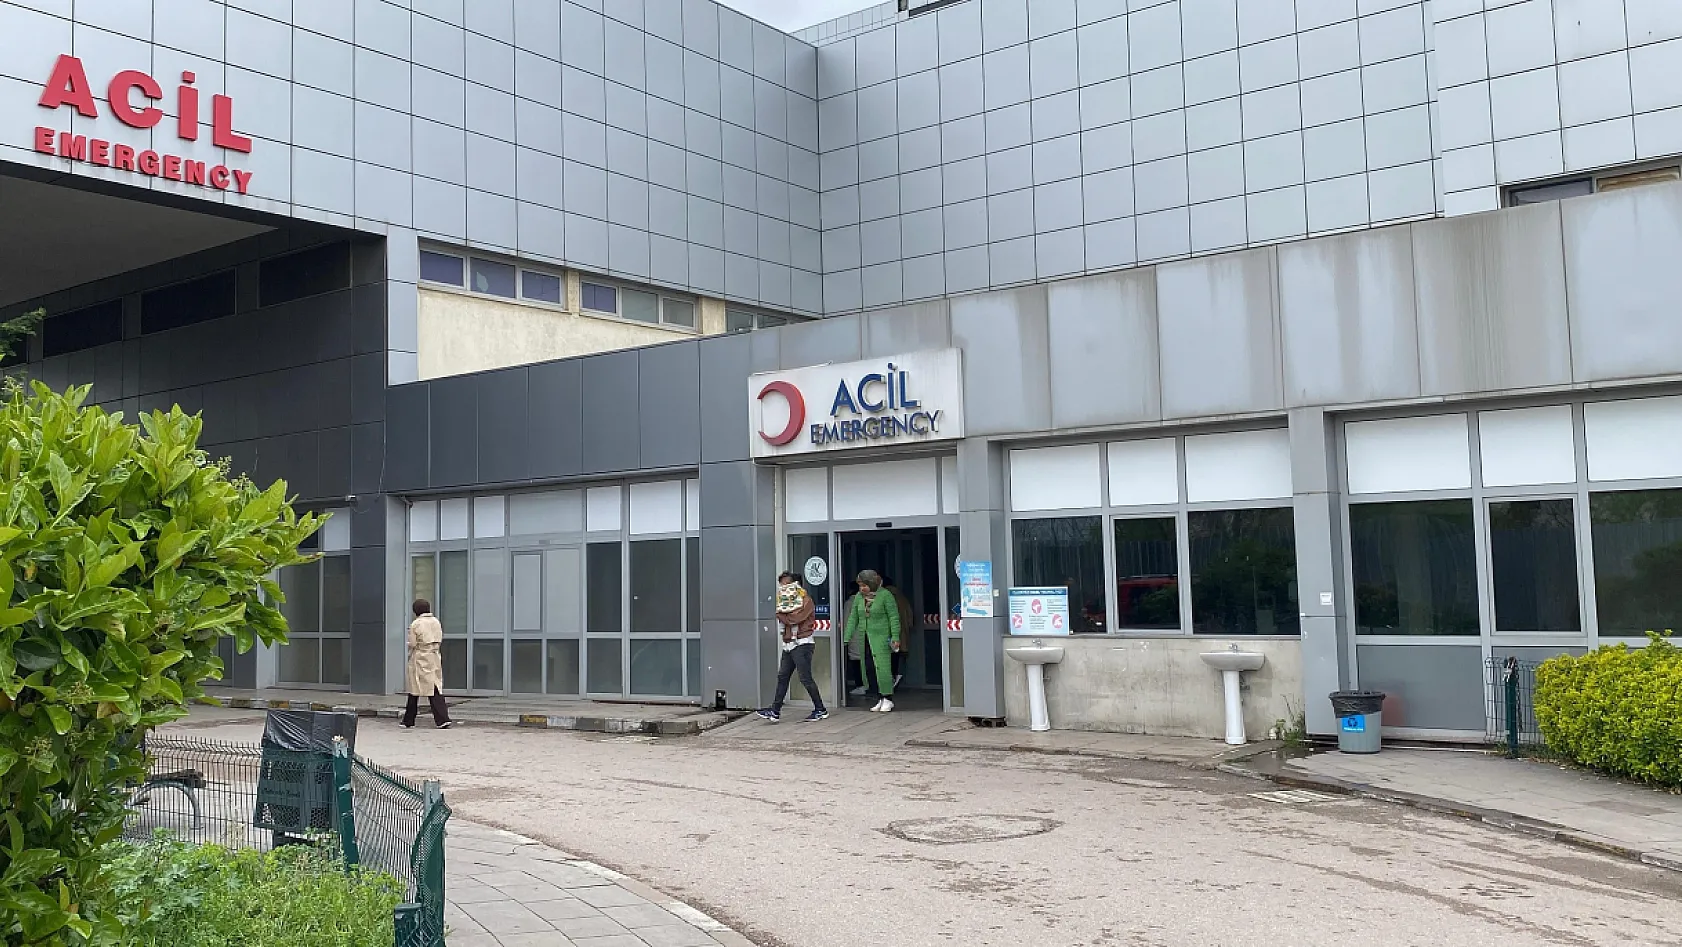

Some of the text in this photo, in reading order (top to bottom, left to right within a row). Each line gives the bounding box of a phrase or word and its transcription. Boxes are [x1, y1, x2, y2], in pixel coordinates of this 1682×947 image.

[38, 54, 252, 153] ACİL
[34, 126, 253, 195] EMERGENCY
[830, 362, 920, 416] ACİL
[810, 409, 943, 444] EMERGENCY
